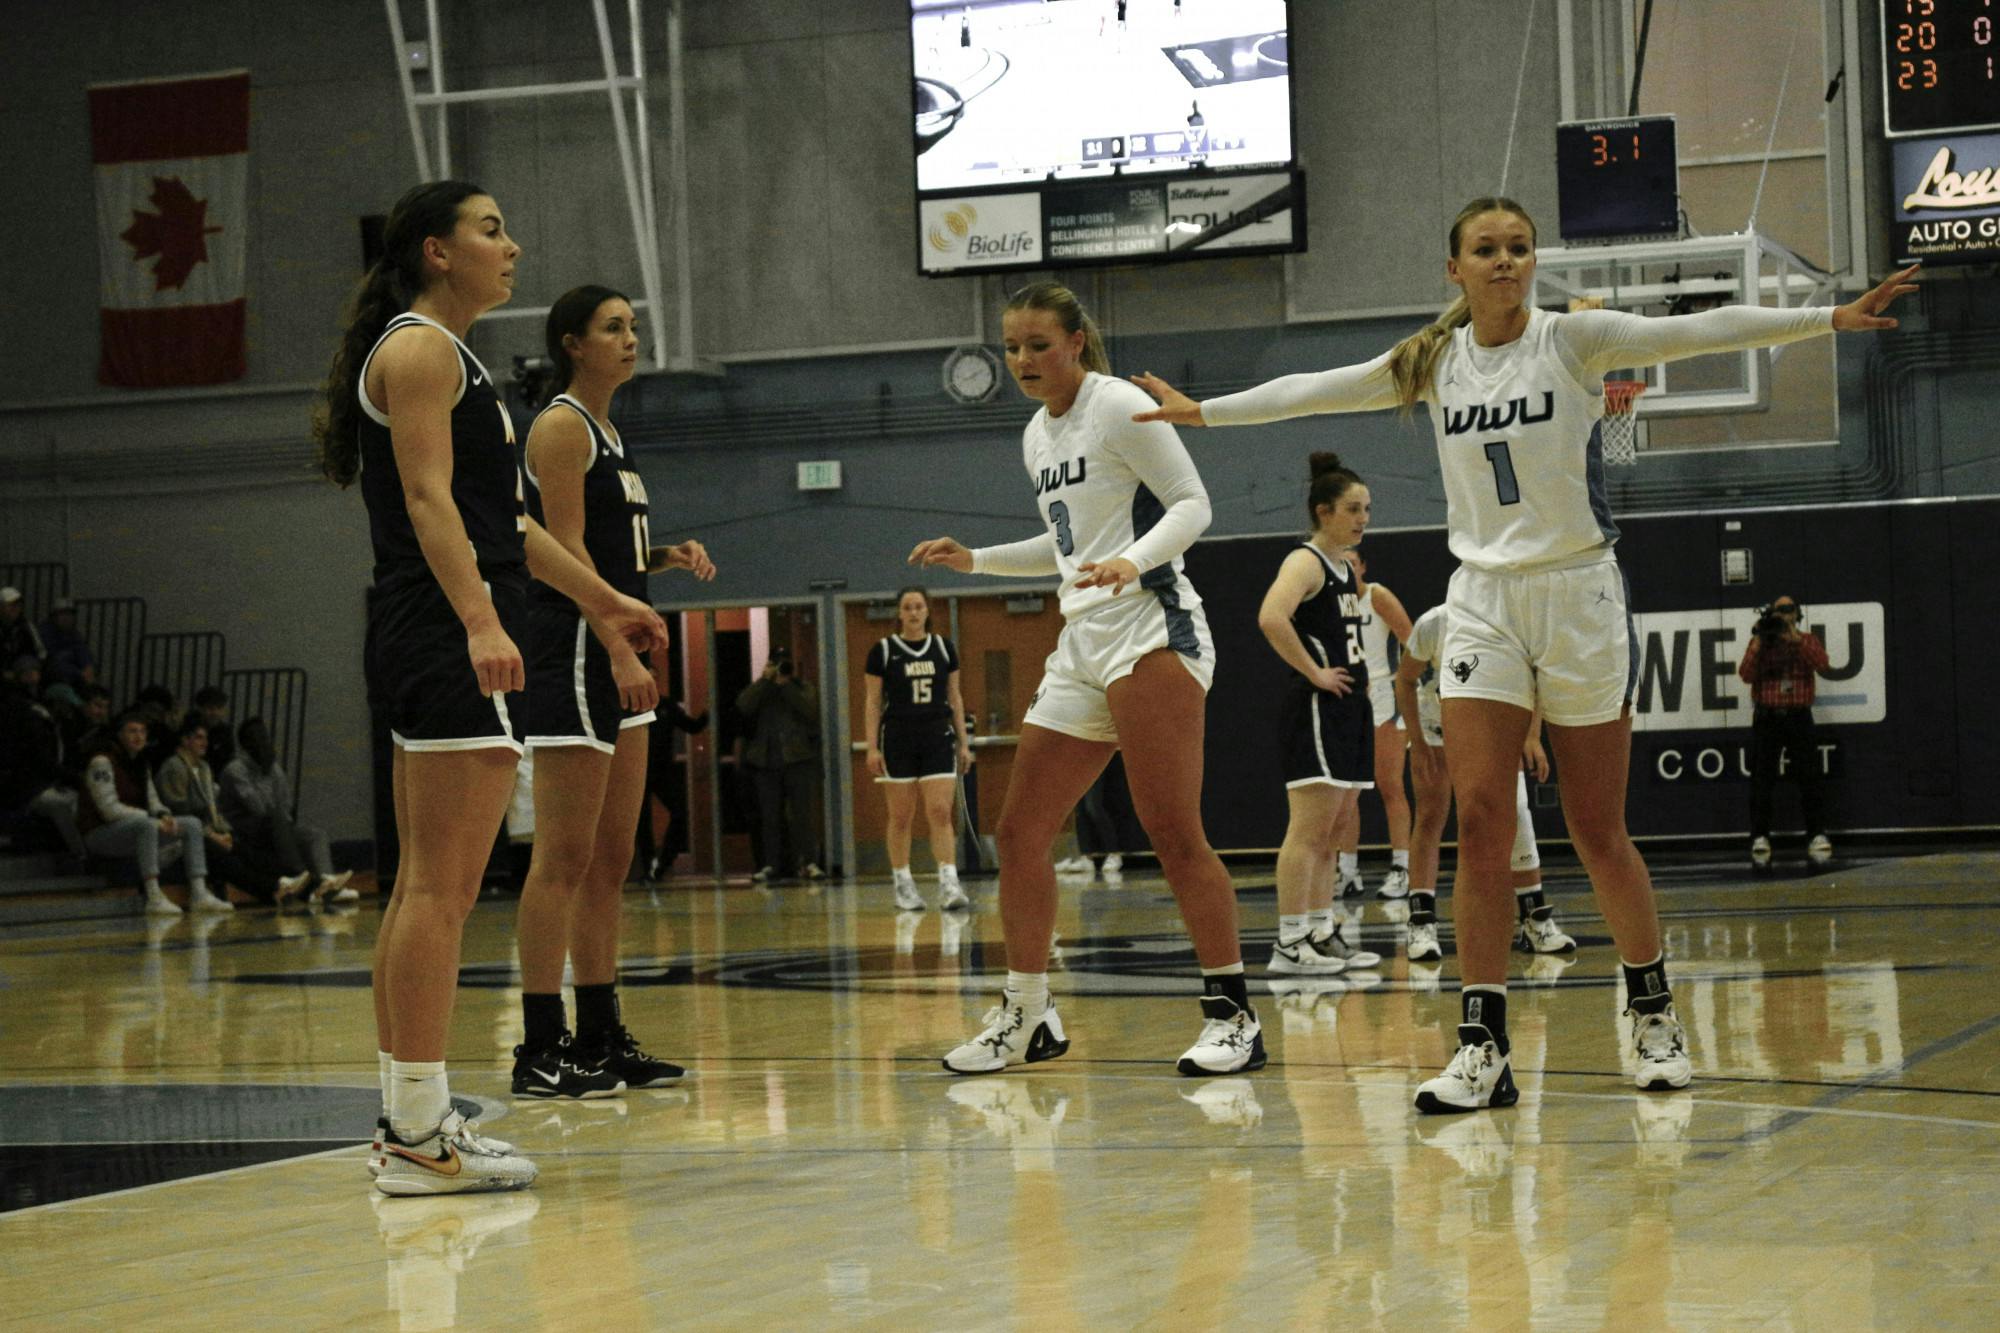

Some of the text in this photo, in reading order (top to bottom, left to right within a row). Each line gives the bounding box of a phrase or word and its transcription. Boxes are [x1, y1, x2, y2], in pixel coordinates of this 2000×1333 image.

[1896, 21, 1936, 52] 20
[1974, 17, 1992, 46] 0
[1897, 59, 1938, 90] 23
[1986, 56, 1994, 80] 1
[1592, 134, 1641, 166] 3.1
[1050, 212, 1116, 227] FOUR POINTS
[1050, 226, 1114, 242] BELLINGHAM
[1117, 224, 1149, 237] HOTEL
[1908, 220, 1972, 243] AUTO
[967, 230, 1034, 257] BioLife
[1051, 238, 1156, 257] CONFERENCE CENTER
[1964, 240, 1986, 254] Auto
[1442, 390, 1555, 436] WWU
[1483, 440, 1521, 507] 1
[1049, 499, 1075, 557] 3
[1637, 621, 1865, 714] WEU
[911, 677, 934, 705] 15
